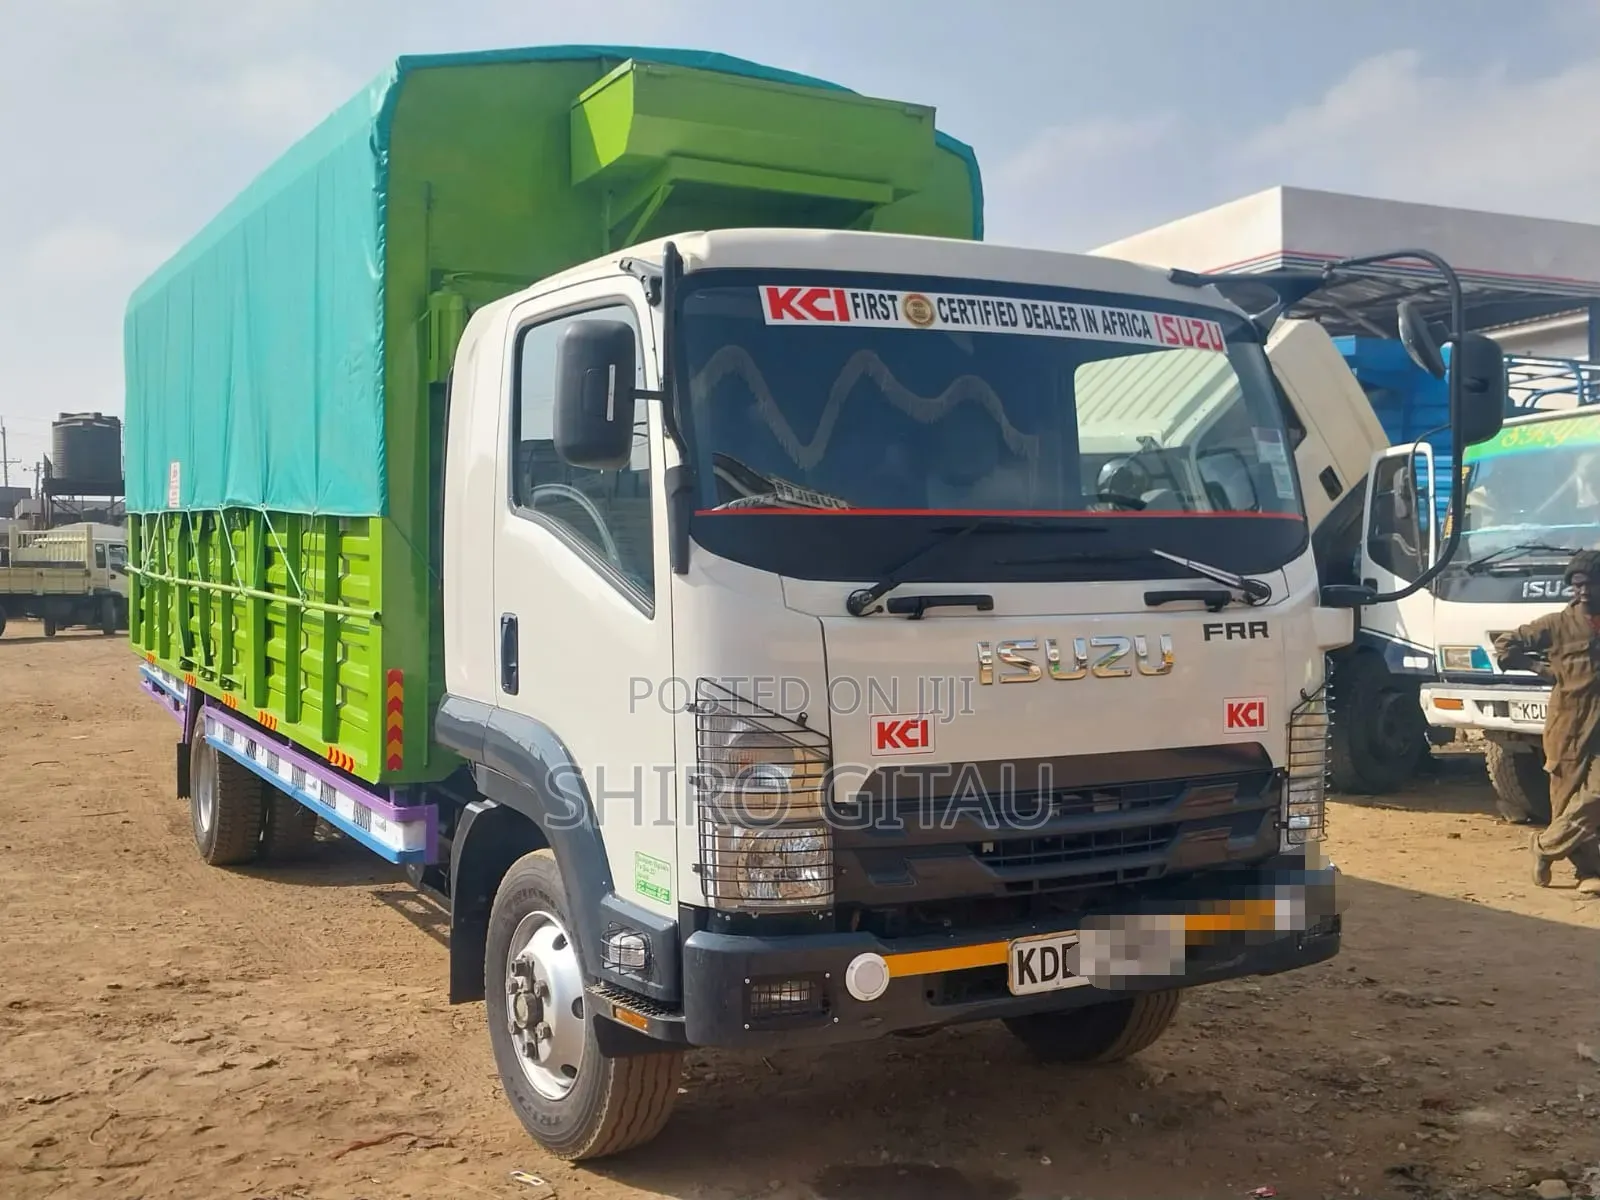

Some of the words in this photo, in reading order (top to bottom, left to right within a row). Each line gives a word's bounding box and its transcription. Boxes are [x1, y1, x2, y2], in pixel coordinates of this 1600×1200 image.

[766, 287, 850, 322] KCI
[851, 292, 899, 320] FIRST
[937, 297, 1018, 327] CERTIFIED
[1021, 303, 1081, 332] DEALER
[1080, 308, 1099, 333] IN
[1101, 309, 1153, 339] AFRICA
[1153, 314, 1224, 352] ISUZU
[1203, 620, 1270, 641] FRR
[977, 634, 1176, 685] ISUZU
[1226, 702, 1265, 728] KCI
[876, 719, 929, 749] KCI
